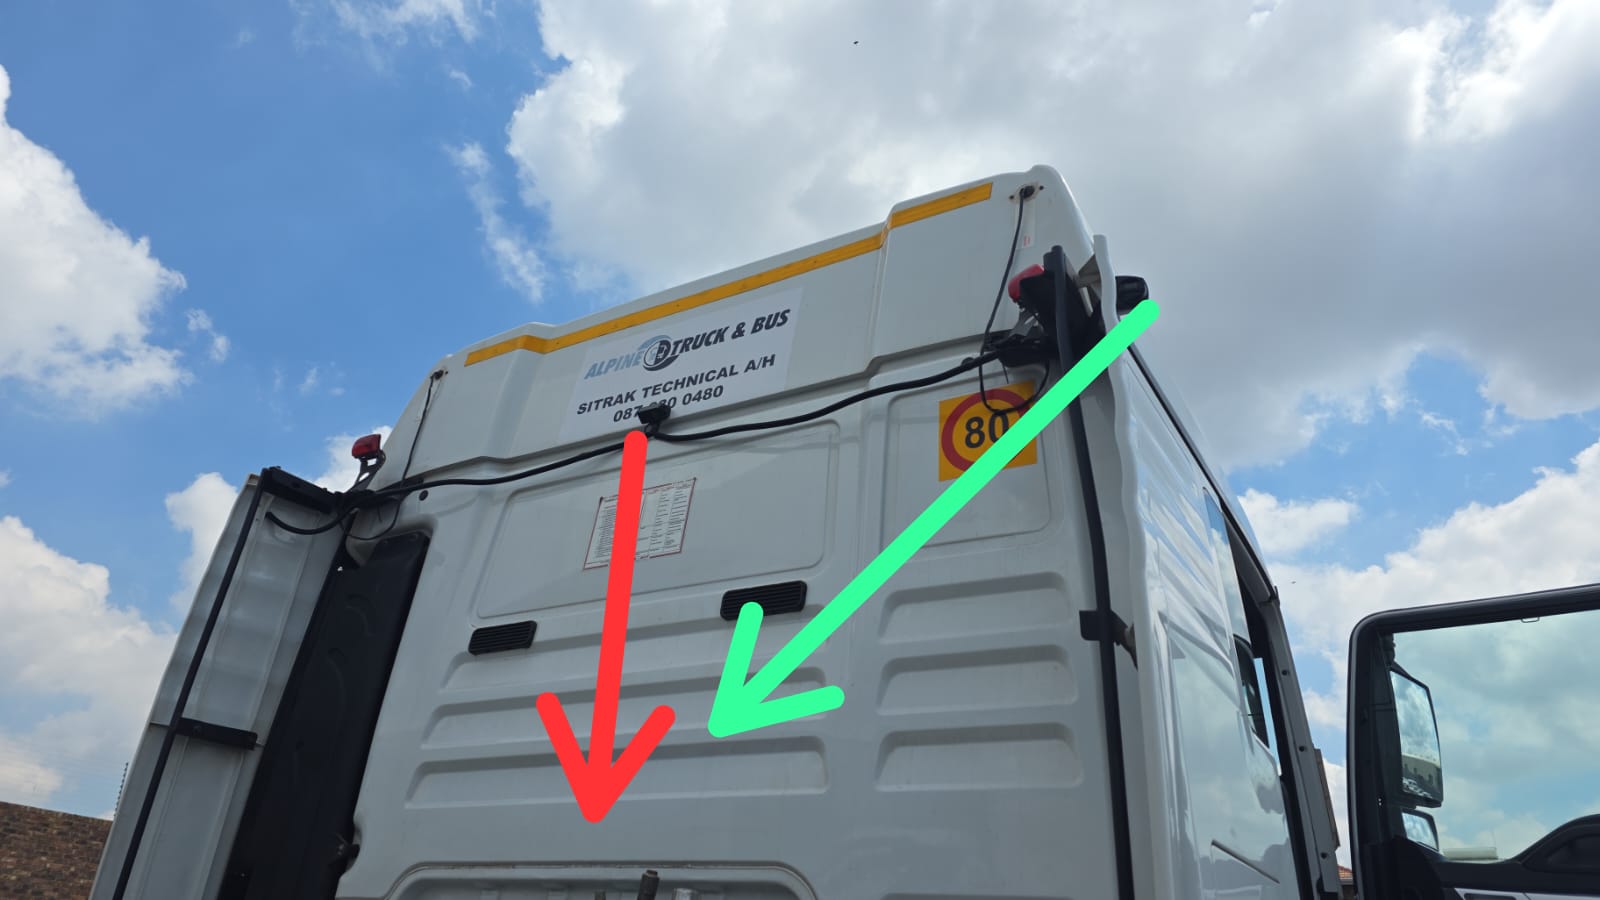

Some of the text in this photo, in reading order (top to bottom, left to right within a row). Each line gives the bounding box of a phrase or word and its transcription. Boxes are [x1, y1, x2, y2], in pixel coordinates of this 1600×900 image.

[583, 309, 791, 380] ALPINE TRUCK & BUS
[577, 353, 776, 415] SITRAK TECHNICAL A/H
[613, 405, 643, 422] 087
[682, 385, 724, 405] 0480
[965, 411, 1009, 448] 80
